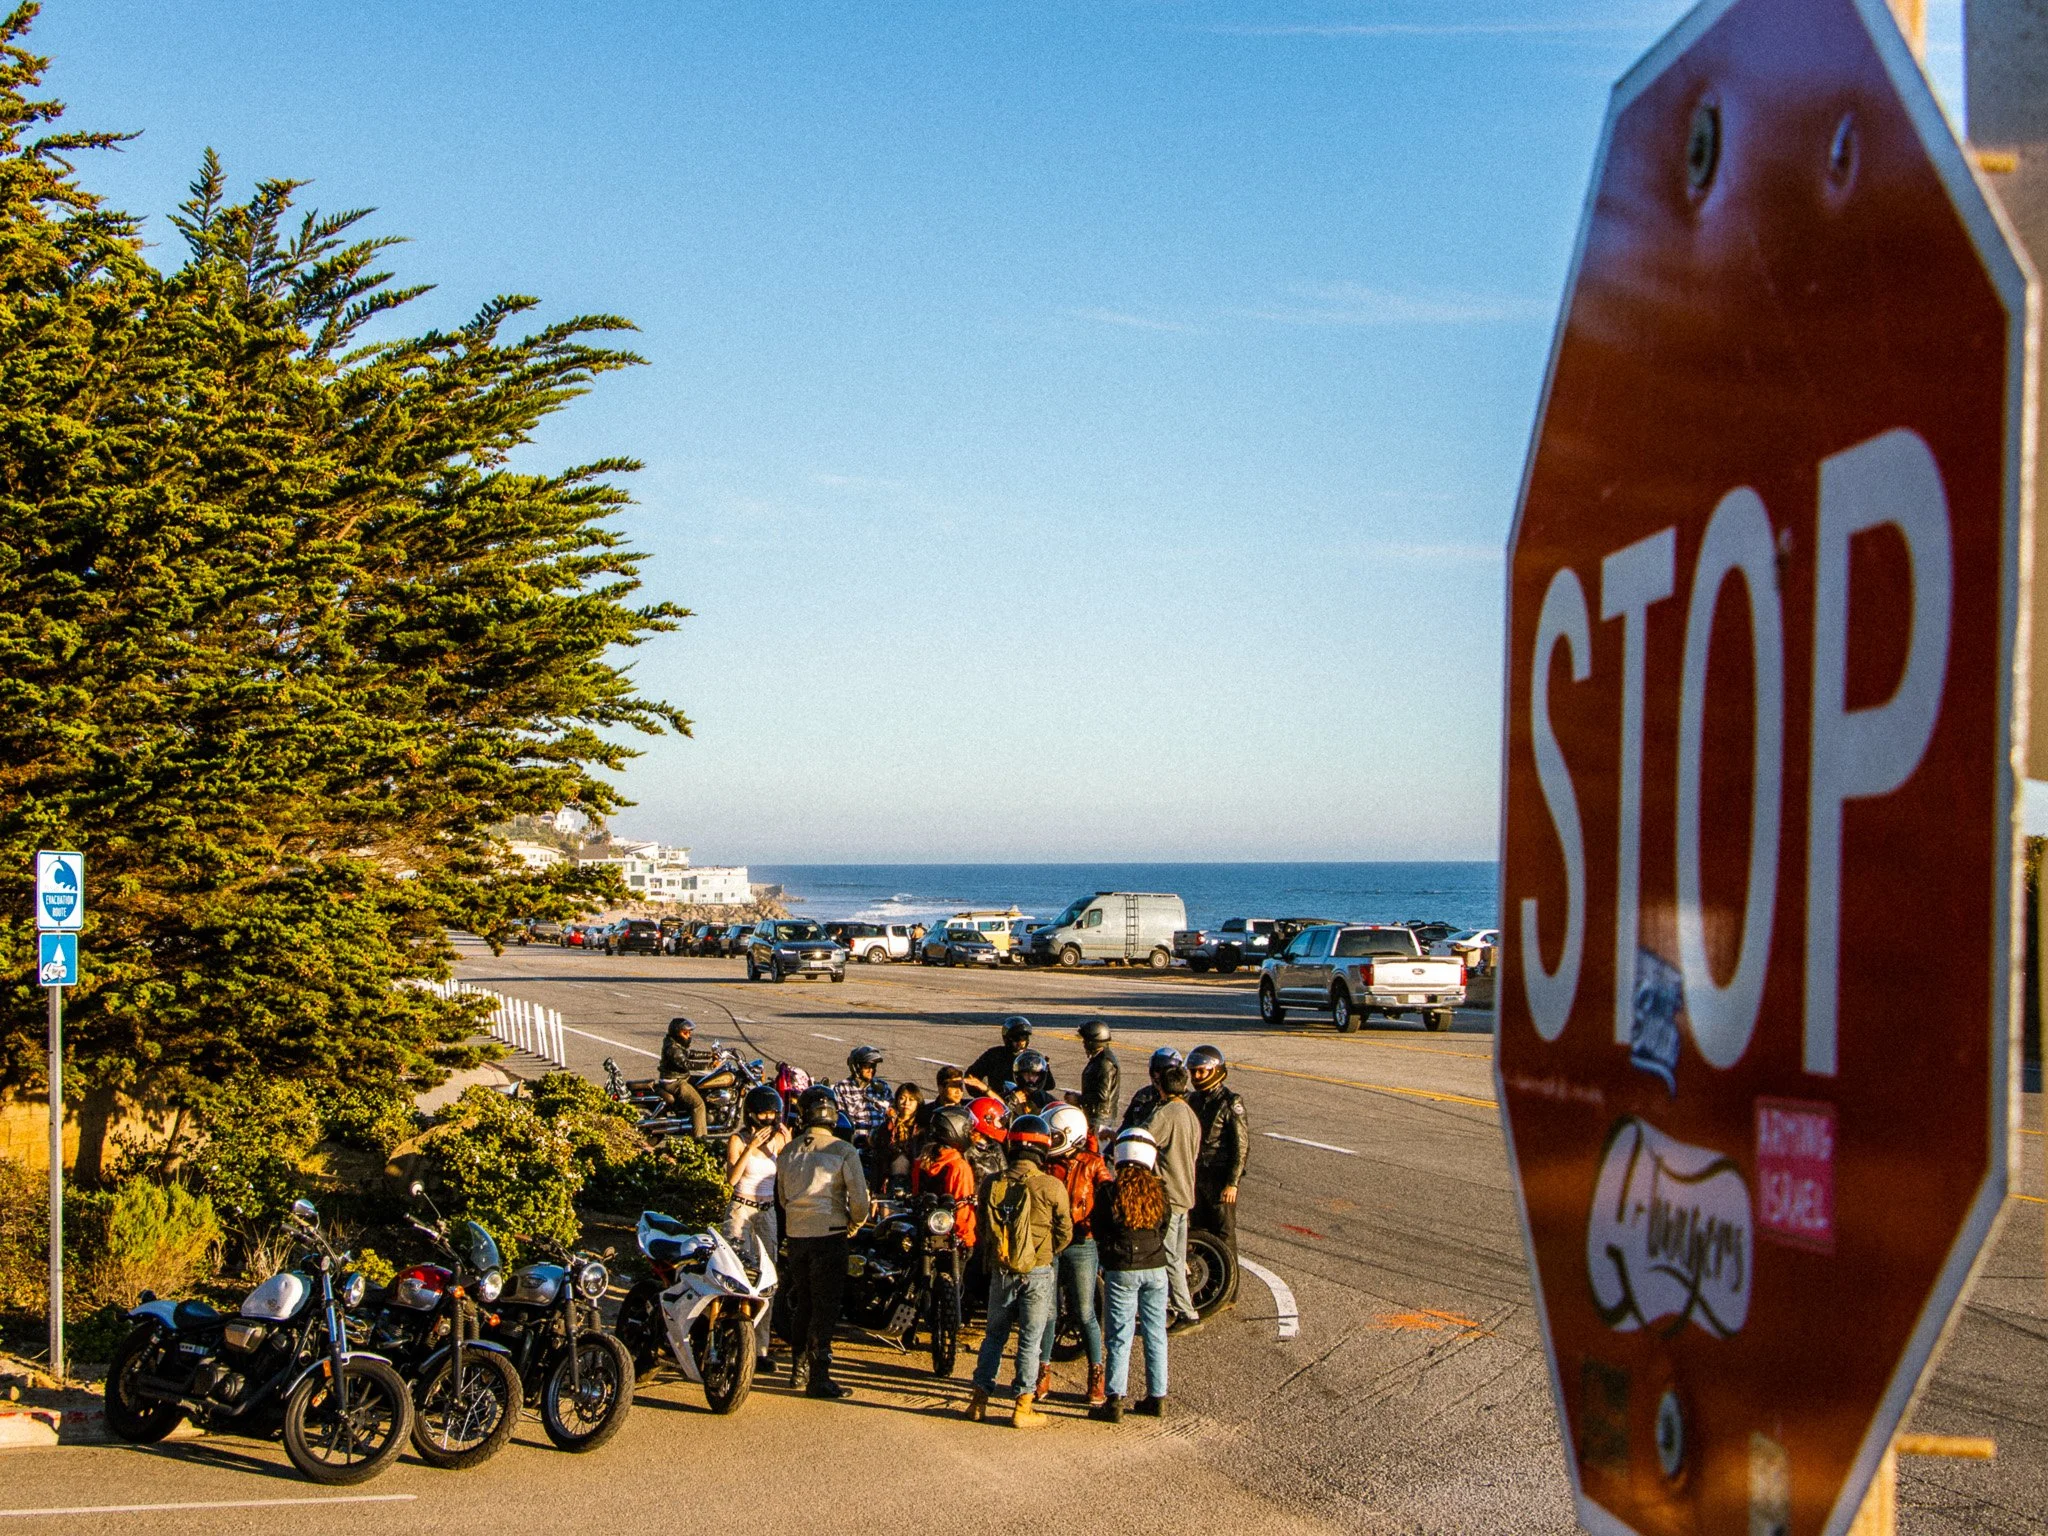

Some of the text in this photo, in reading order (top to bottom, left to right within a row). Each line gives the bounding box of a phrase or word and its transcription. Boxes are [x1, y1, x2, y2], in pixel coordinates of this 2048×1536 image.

[1521, 426, 1953, 1077] STOP
[46, 895, 73, 905] EVACUATION
[52, 907, 67, 917] ROUTE
